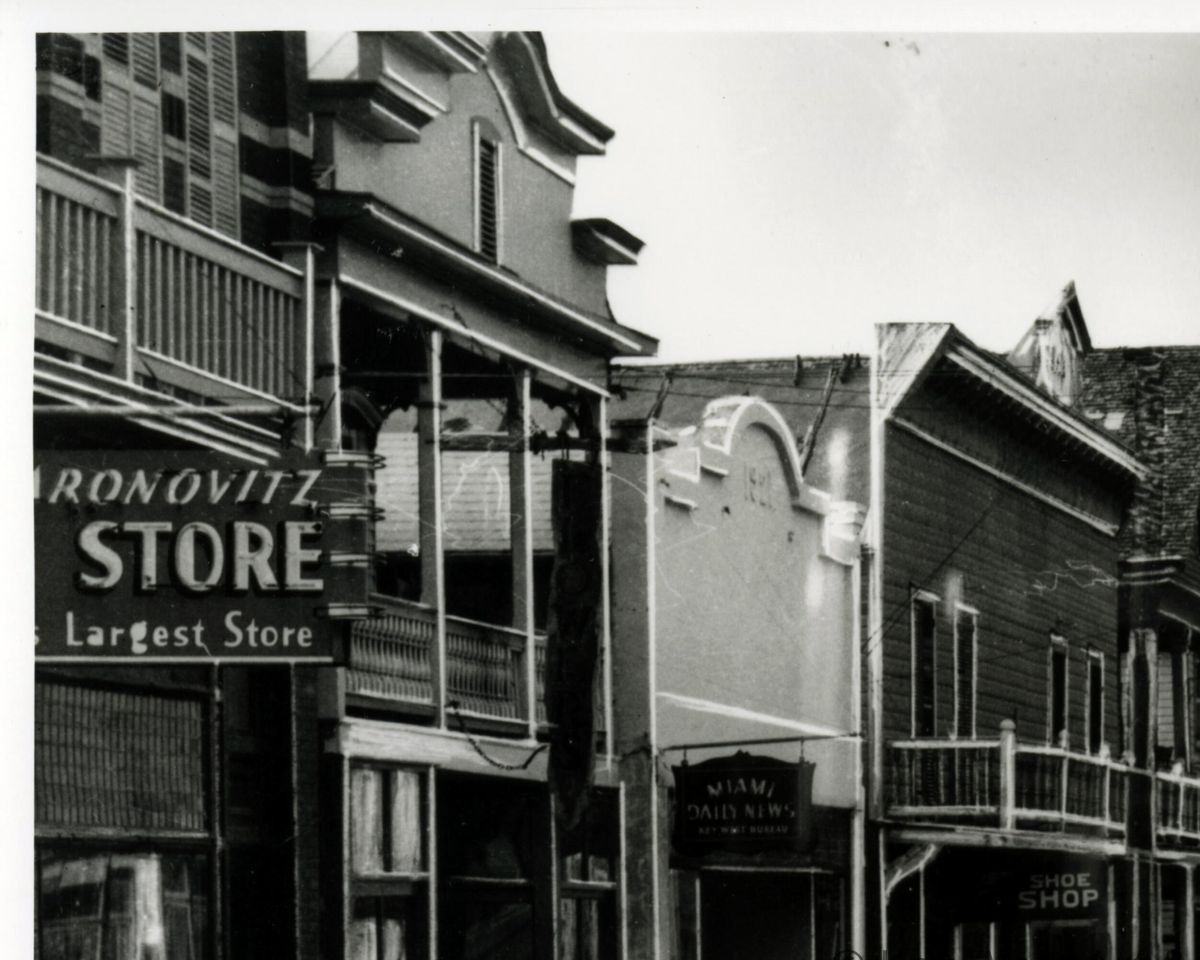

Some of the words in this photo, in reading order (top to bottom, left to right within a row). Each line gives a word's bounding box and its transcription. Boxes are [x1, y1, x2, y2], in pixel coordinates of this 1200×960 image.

[78, 519, 325, 592] STORE
[66, 610, 205, 655] Largest
[224, 610, 313, 648] Store
[706, 778, 776, 798] MIAMI
[687, 802, 738, 821] DAILY
[744, 802, 797, 820] NEWS
[1030, 872, 1092, 889] SHOE
[1018, 889, 1099, 909] SHOP
